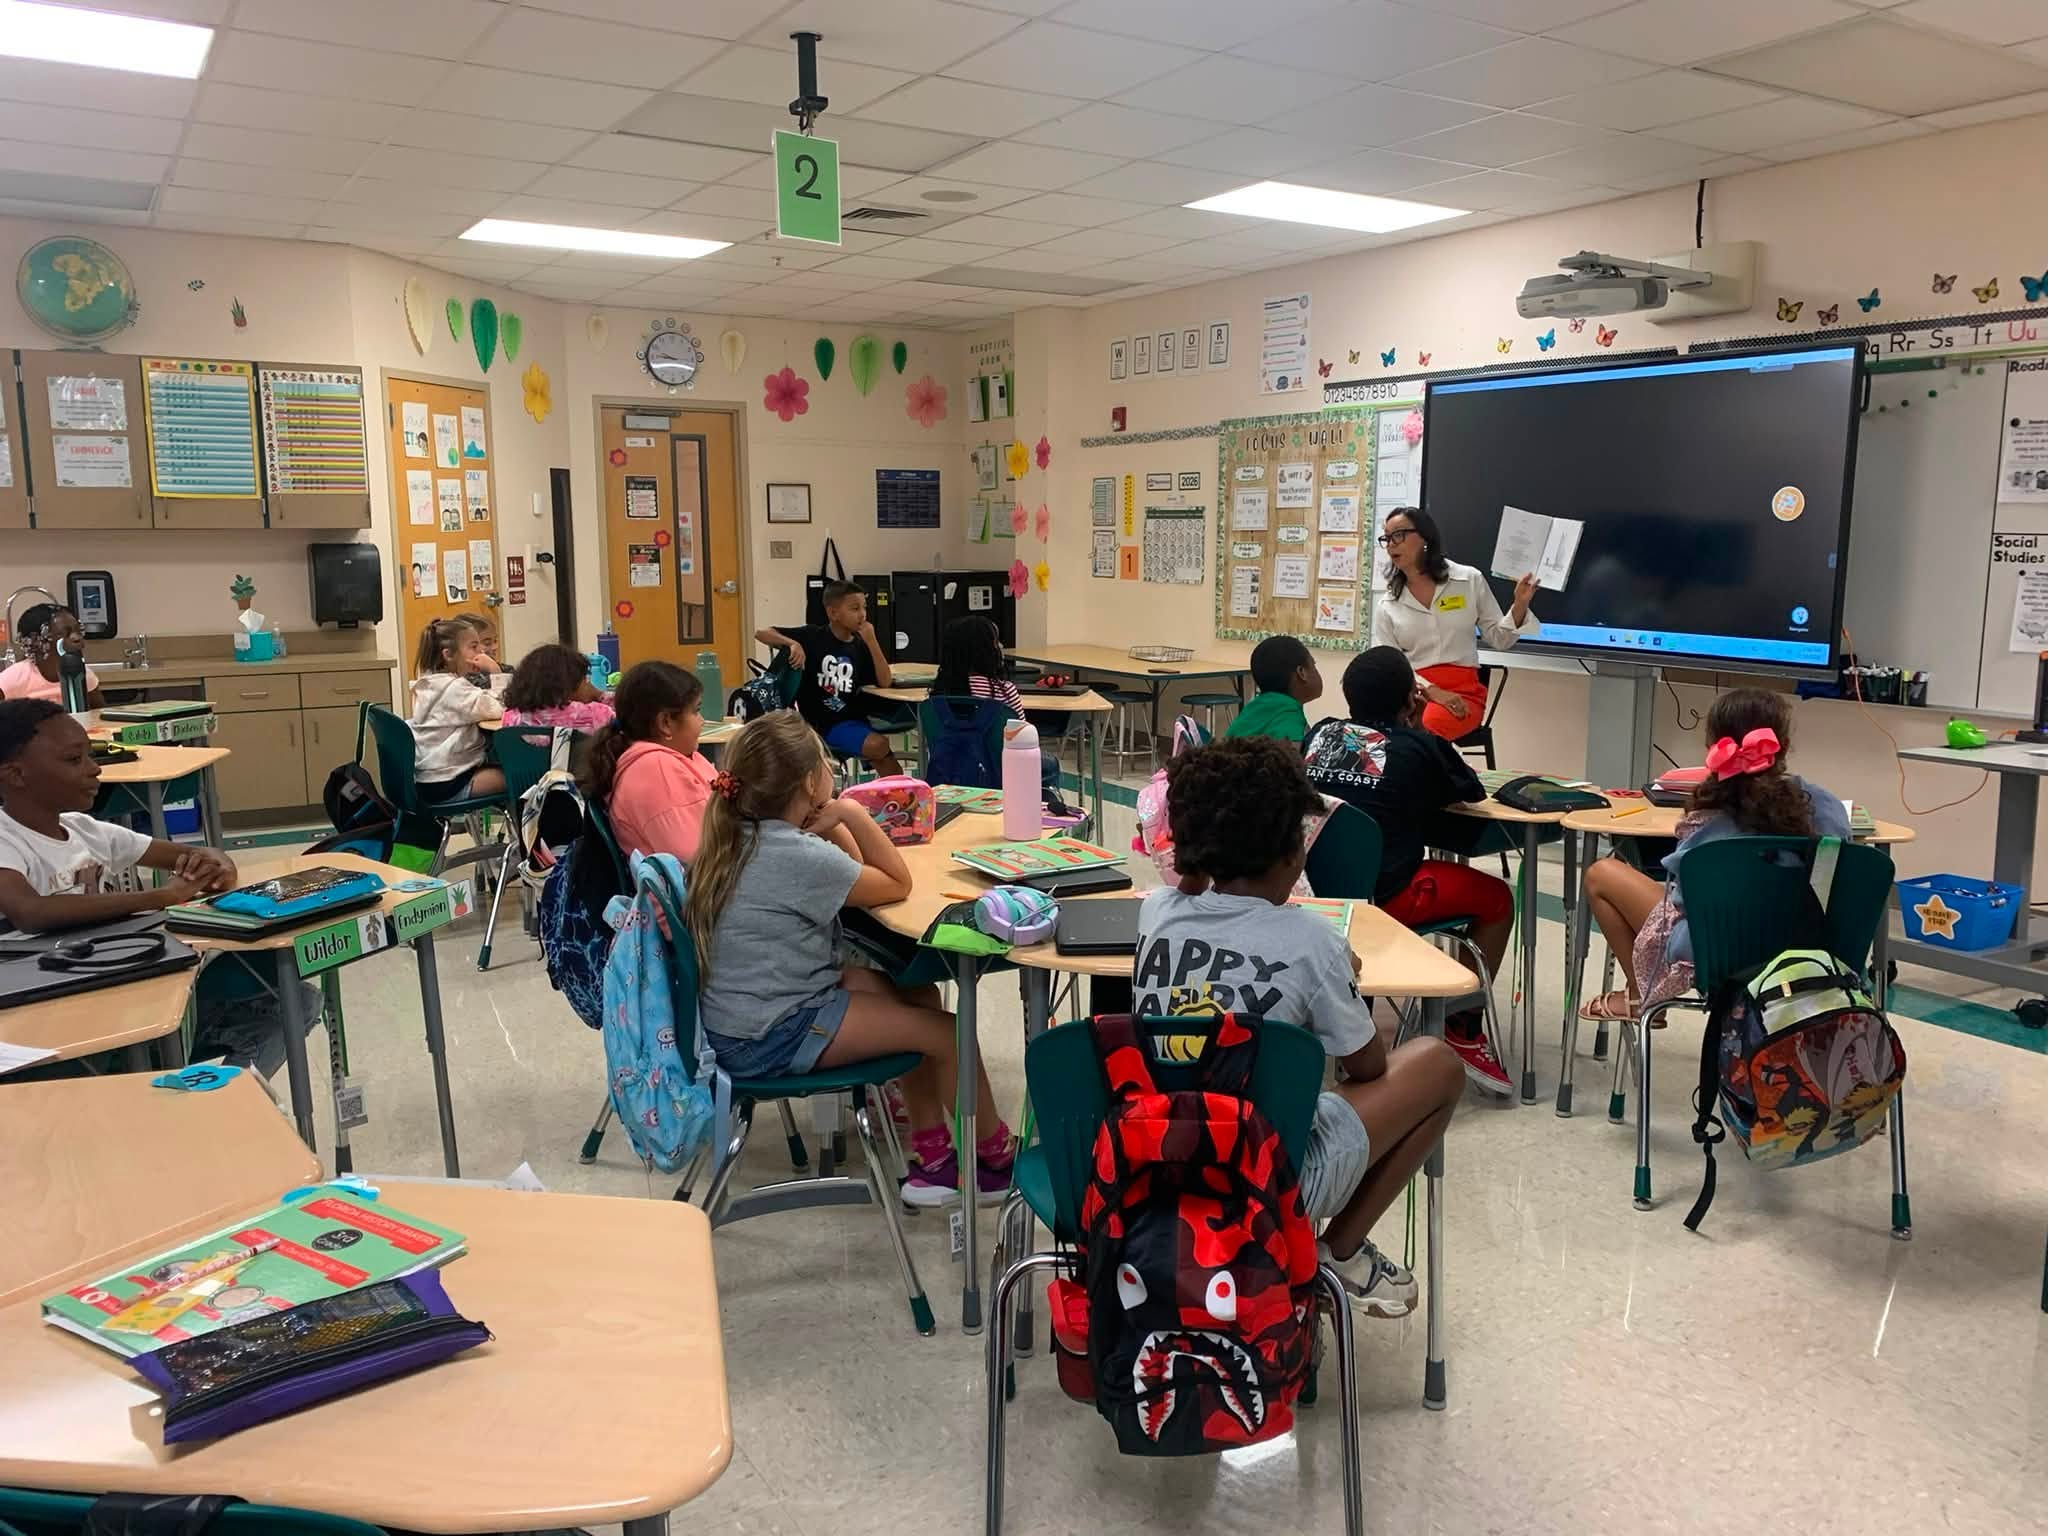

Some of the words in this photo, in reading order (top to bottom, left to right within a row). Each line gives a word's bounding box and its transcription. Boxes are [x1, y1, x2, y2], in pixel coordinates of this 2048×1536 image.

[795, 154, 822, 200] 2
[1114, 347, 1123, 359] W
[1164, 337, 1170, 349] C
[1188, 333, 1195, 345] O
[1216, 328, 1223, 340] R
[1890, 332, 1915, 352] Rr
[1928, 329, 1954, 349] Ss
[1969, 324, 1993, 345] Tt
[2008, 320, 2038, 342] Uu
[1246, 431, 1286, 452] FOCUS
[1309, 428, 1344, 446] WALL
[1993, 535, 2038, 549] Social
[1993, 550, 2045, 564] Studies
[822, 654, 854, 679] GO
[1337, 772, 1381, 787] COAST
[398, 901, 447, 930] Endymion
[304, 932, 352, 965] Wildor
[1133, 932, 1290, 989] APPY
[331, 1230, 358, 1243] 3rd
